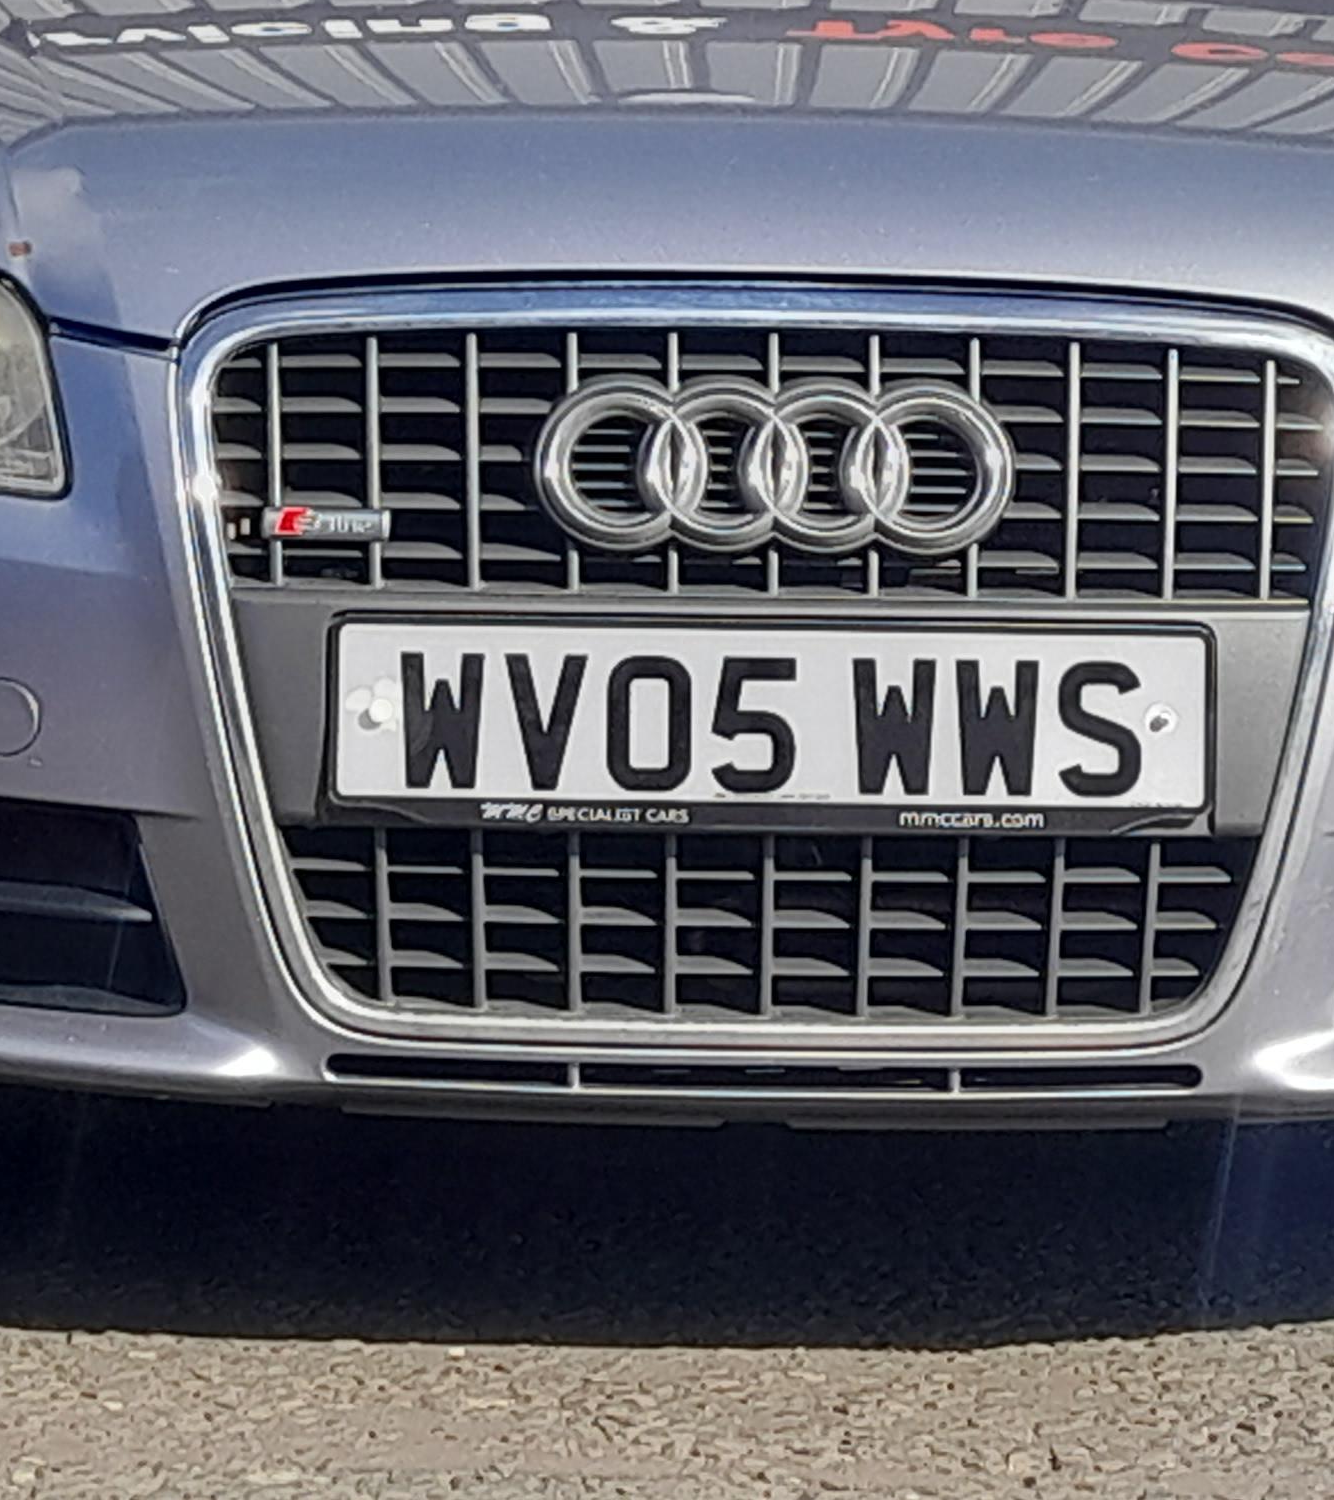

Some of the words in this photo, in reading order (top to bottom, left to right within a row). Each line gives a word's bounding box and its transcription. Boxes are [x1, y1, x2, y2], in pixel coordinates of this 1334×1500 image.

[399, 651, 798, 793] WV05
[852, 657, 1143, 797] WWS
[547, 805, 640, 821] SPECIALIST
[645, 808, 690, 823] CARS
[898, 810, 1045, 828] mmccars.com
